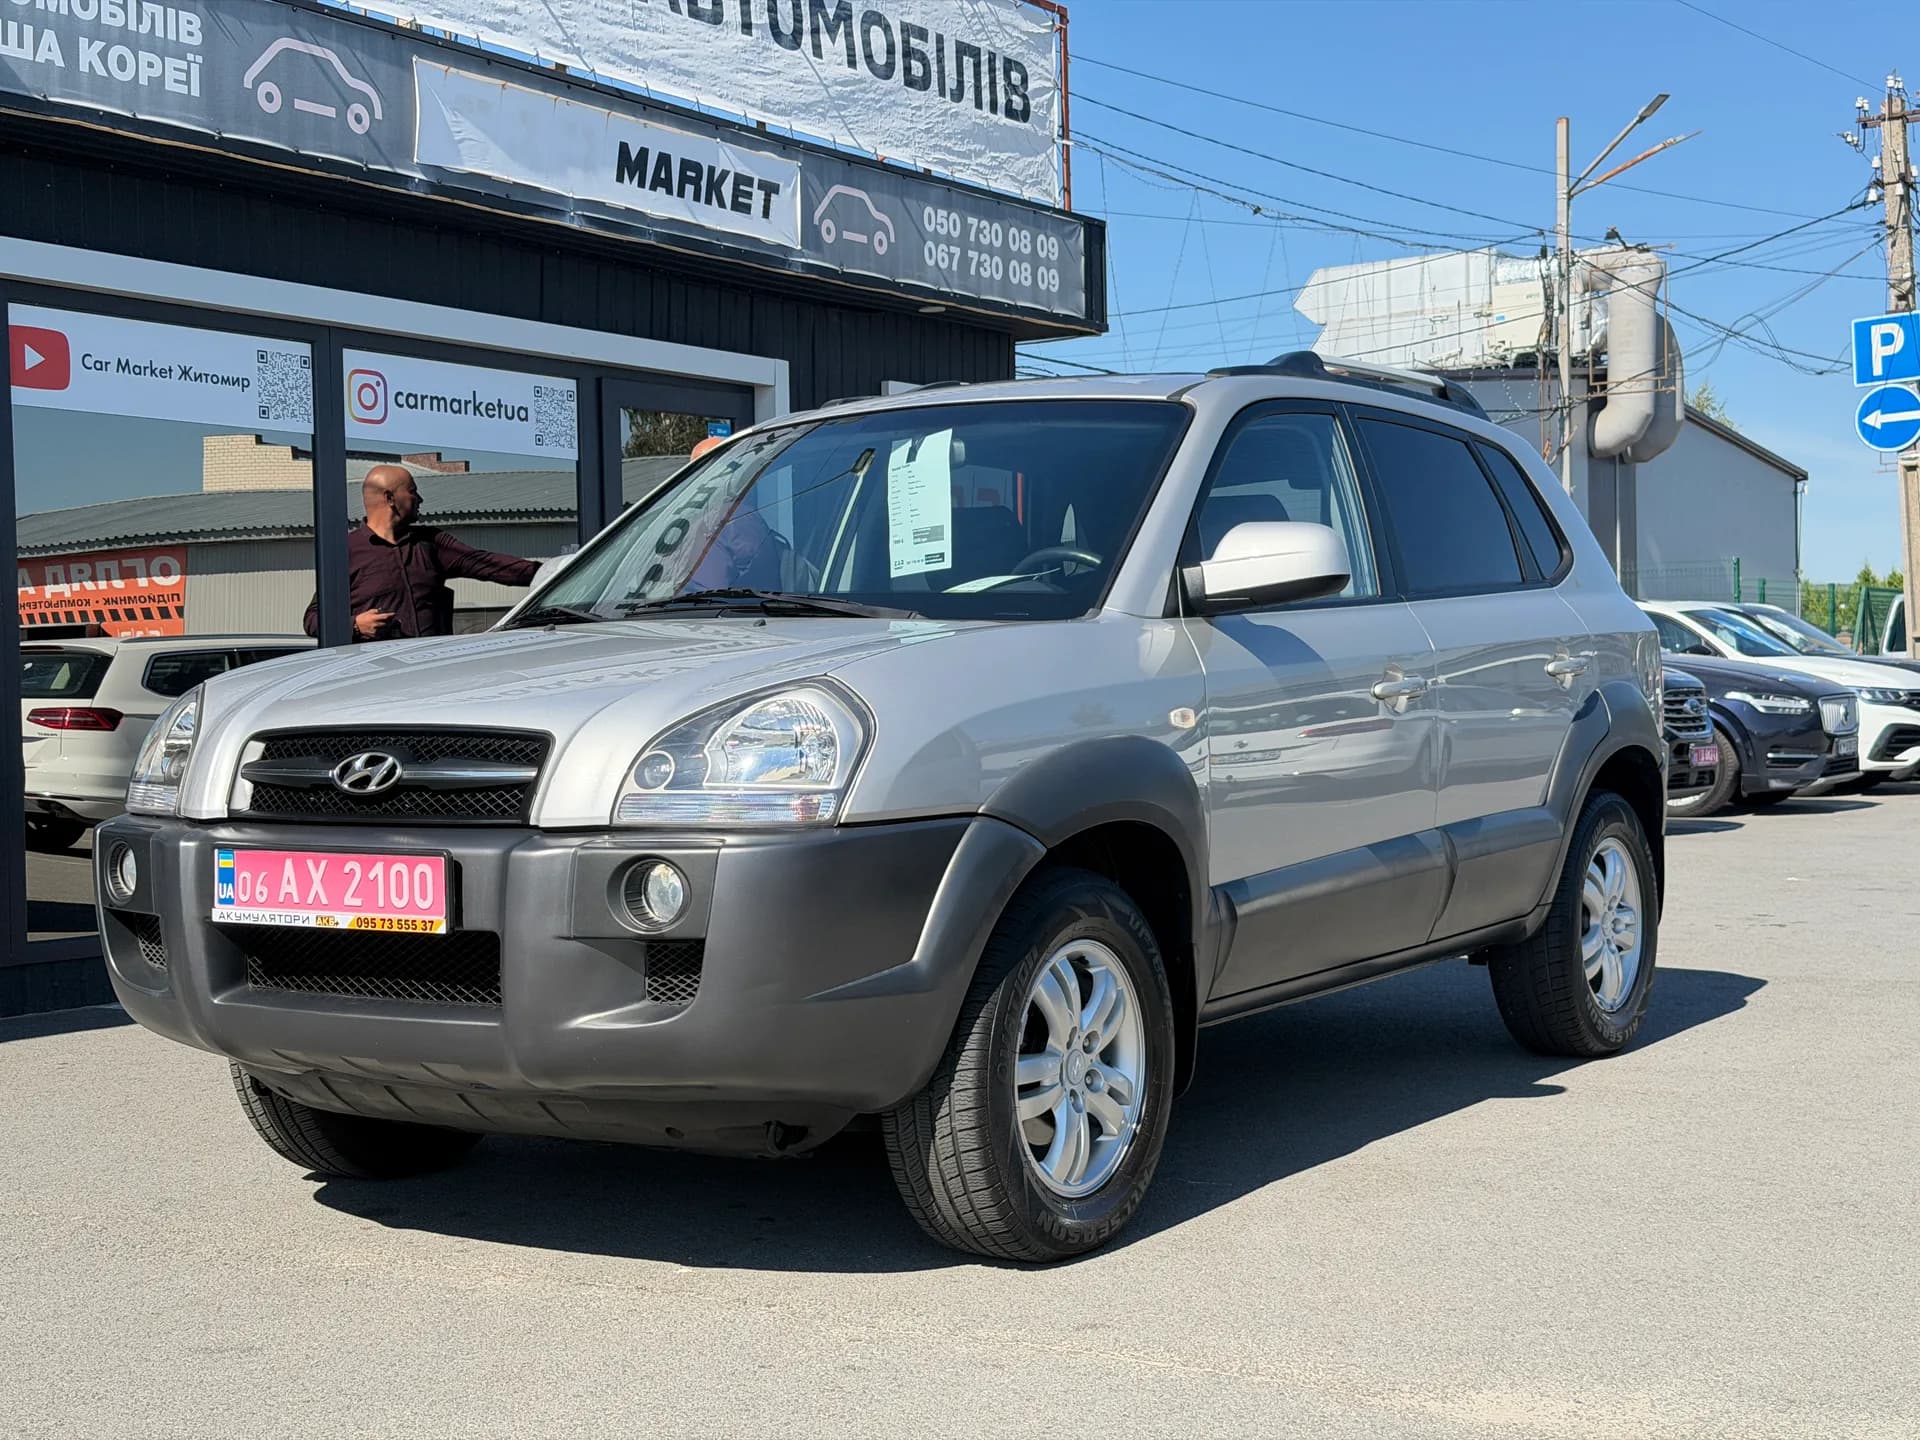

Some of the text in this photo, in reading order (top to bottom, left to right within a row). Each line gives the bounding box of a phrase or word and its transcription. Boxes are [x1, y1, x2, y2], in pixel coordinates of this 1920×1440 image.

[79, 36, 203, 97] КОРЕЇ
[616, 141, 781, 219] MARKET
[923, 206, 1059, 260] 050 730 08 09
[924, 240, 1060, 292] 067 730 08 09
[82, 353, 251, 392] Car Market Житомир
[1871, 322, 1904, 376] P
[394, 390, 529, 422] carmarketua
[219, 858, 434, 911] UA 06 AX 2100
[218, 911, 310, 925] АКУМУЛЯТОРИ
[356, 916, 377, 929] 095
[380, 918, 393, 930] 73
[397, 918, 418, 931] 555
[421, 920, 435, 932] 37
